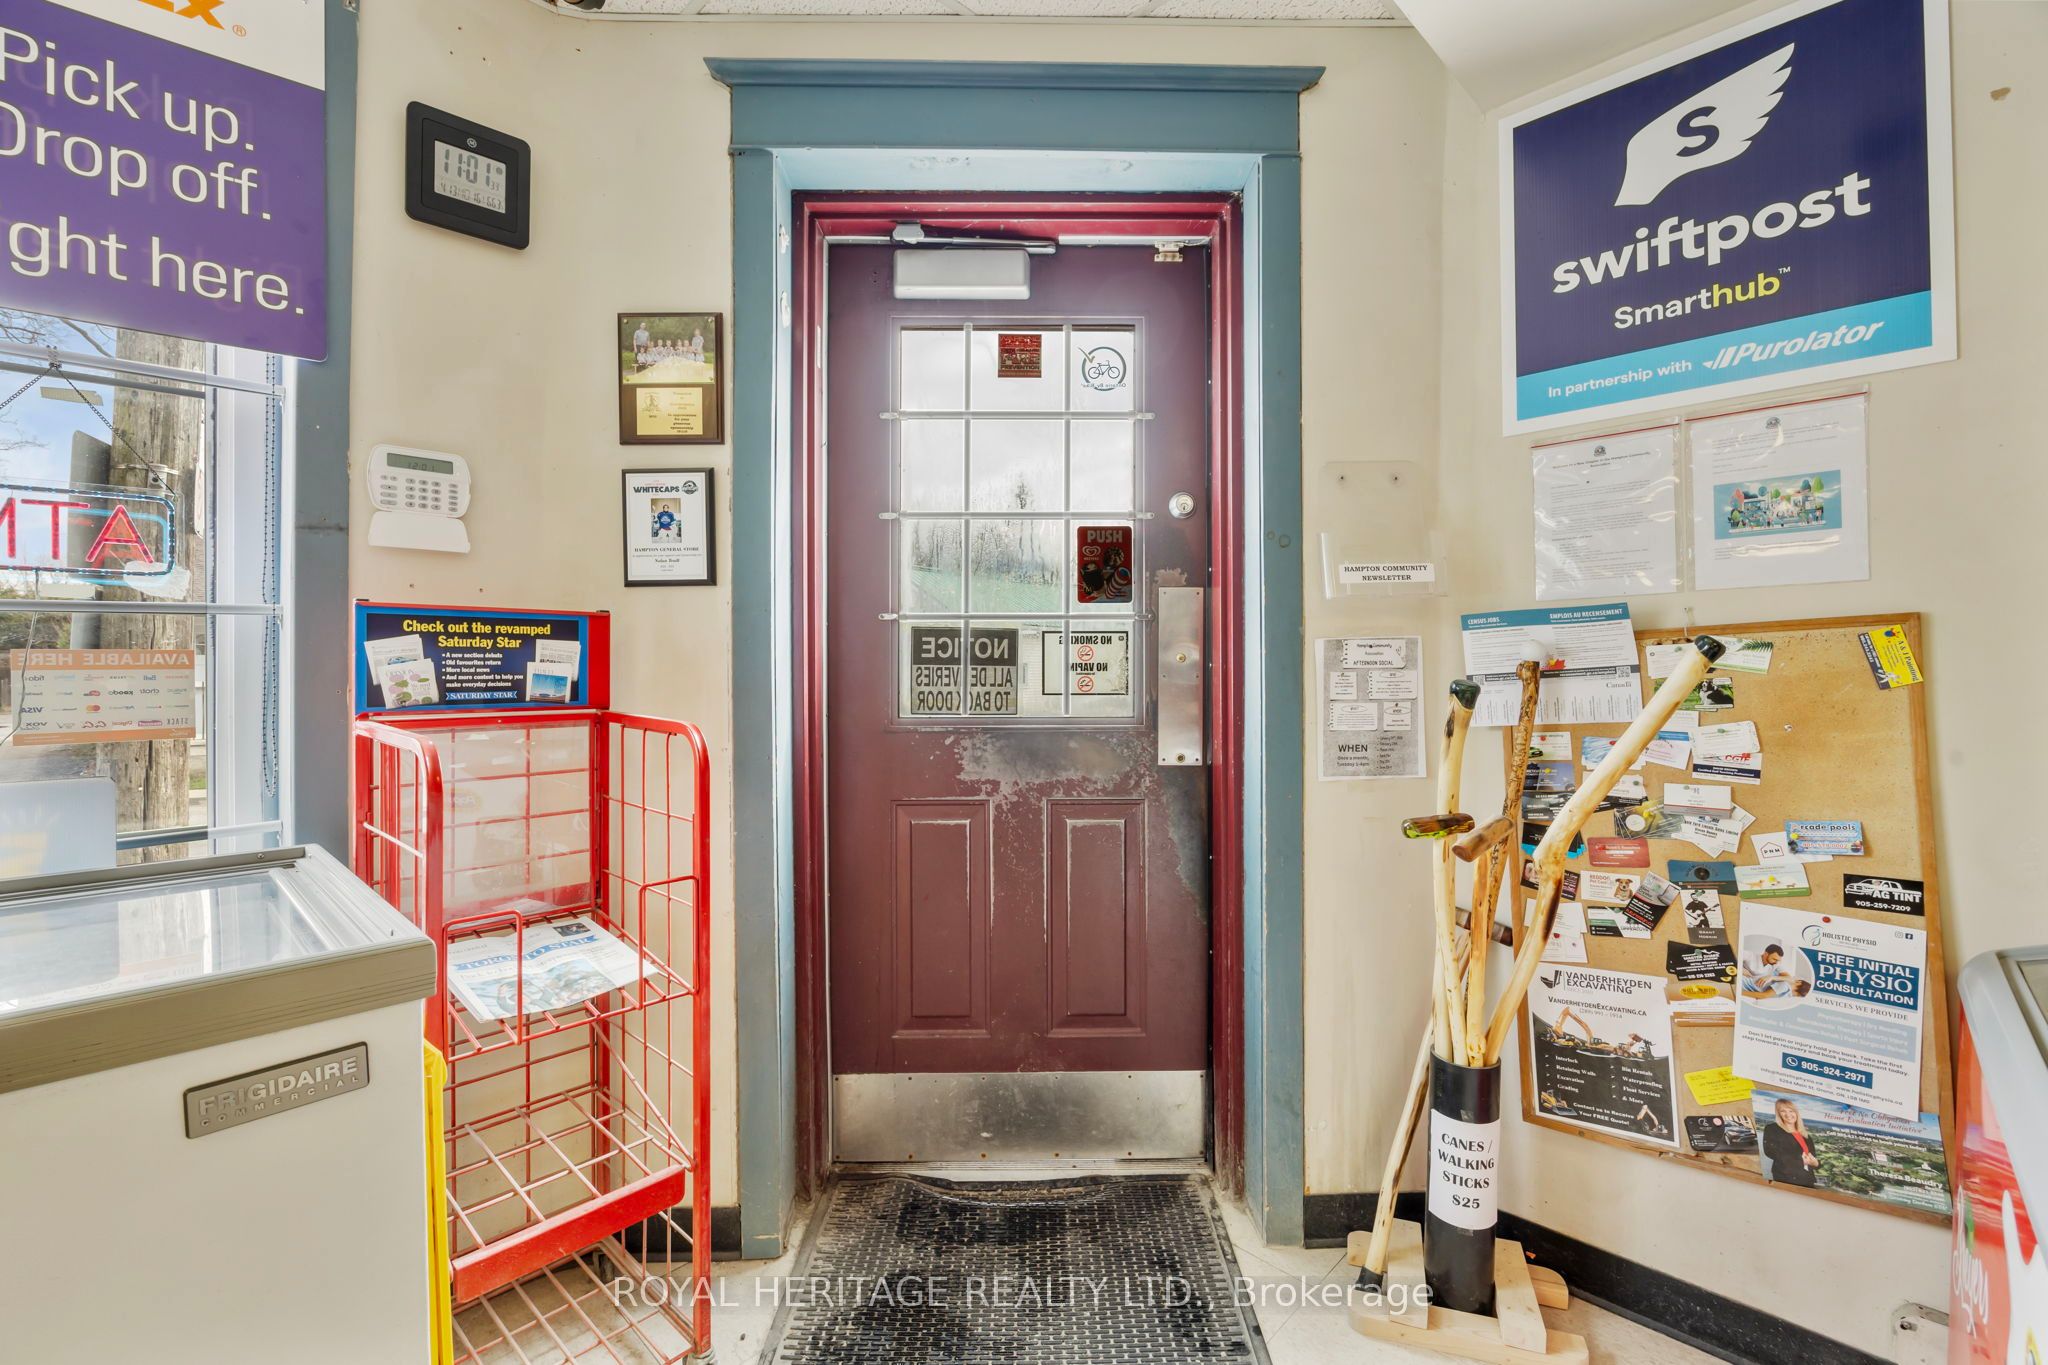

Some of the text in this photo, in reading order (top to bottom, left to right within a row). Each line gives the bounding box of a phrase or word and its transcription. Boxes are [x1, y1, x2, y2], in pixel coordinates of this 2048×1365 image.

[0, 26, 254, 152] Pick up.
[172, 161, 271, 220] off.
[1552, 171, 1872, 294] swiftpost
[152, 236, 304, 315] here.
[1548, 319, 1885, 398] In partnership with Purolator
[1087, 530, 1123, 543] PUSH
[1582, 608, 1623, 617] RECENSEMENT
[402, 620, 551, 636] Check out the revamped
[438, 636, 521, 649] Saturday Star
[1338, 744, 1368, 752] WHEN
[1830, 823, 1856, 832] pools
[1855, 900, 1911, 911] 905-259-7209
[1892, 892, 1922, 903] TINT
[1822, 932, 1877, 946] HOLISTIC PHYSIO
[466, 944, 551, 970] TOROTO
[553, 935, 589, 951] STAR
[1818, 952, 1915, 979] FREE INITIAL
[1565, 971, 1652, 990] VANDERHEYDEN
[1818, 964, 1913, 993] PHYSIO
[1566, 979, 1633, 995] EXCAVATING
[1816, 980, 1914, 1006] CONSULTATION
[1815, 997, 1909, 1021] SERVICES WE PROVIDE
[1794, 1041, 1812, 1049] injury
[1555, 1055, 1578, 1064] Interlock
[1755, 1037, 1779, 1047] towards
[1780, 1043, 1806, 1053] recovery
[1821, 1052, 1836, 1060] book
[1854, 1060, 1887, 1071] treatment
[1888, 1067, 1909, 1077] today.
[1556, 1064, 1596, 1077] Retaining Walls
[1801, 1060, 1866, 1083] 905-924-2971
[199, 1056, 358, 1116] FRIGIDAIRE
[1556, 1074, 1585, 1084] Excavation
[1622, 1076, 1663, 1089] Waterproofing
[1557, 1083, 1579, 1093] Grading
[1638, 1089, 1661, 1098] Services
[201, 1076, 359, 1127] COMMERCIAL
[1573, 1102, 1596, 1111] Contact
[1611, 1110, 1634, 1119] Receive
[1593, 1113, 1609, 1121] FREE
[1824, 1113, 1886, 1128] Home Evaluation
[1441, 1132, 1484, 1153] CANES
[1438, 1148, 1495, 1170] WALKING
[1442, 1169, 1490, 1189] STICKS
[1867, 1168, 1943, 1189] Theresa Beaudry
[1452, 1194, 1481, 1210] $25
